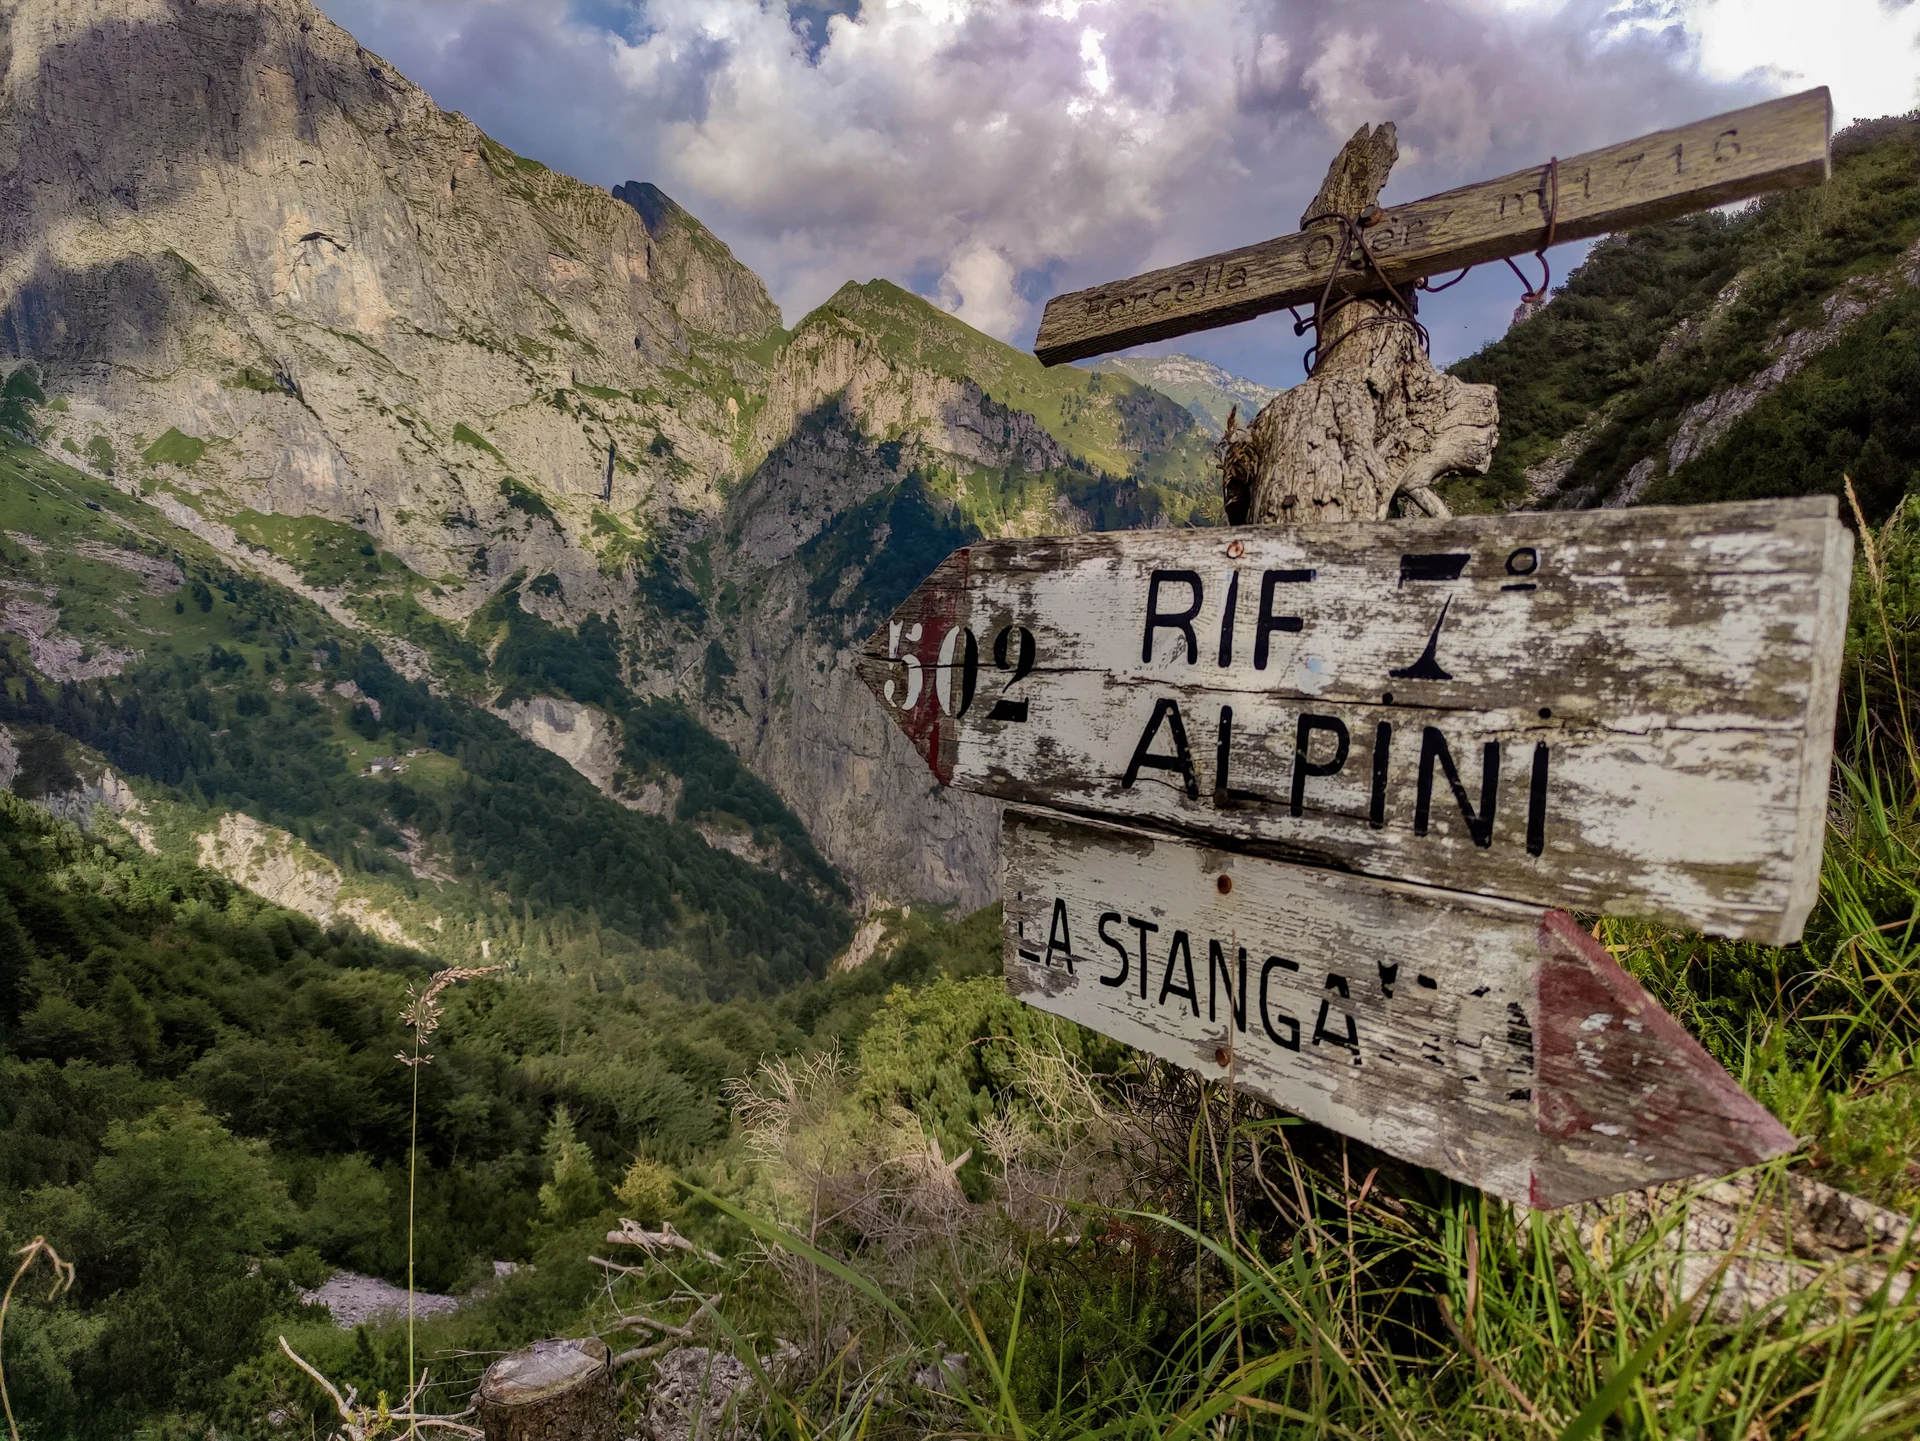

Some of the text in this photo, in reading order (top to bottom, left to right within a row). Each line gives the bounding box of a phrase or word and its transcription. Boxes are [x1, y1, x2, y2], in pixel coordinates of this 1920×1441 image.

[1084, 262, 1248, 319] Forcella
[884, 619, 1036, 722] 502
[1143, 569, 1317, 670] RIF
[1121, 691, 1550, 857] ALPINI
[1018, 890, 1074, 975] LA
[1098, 912, 1361, 1065] STANGA
